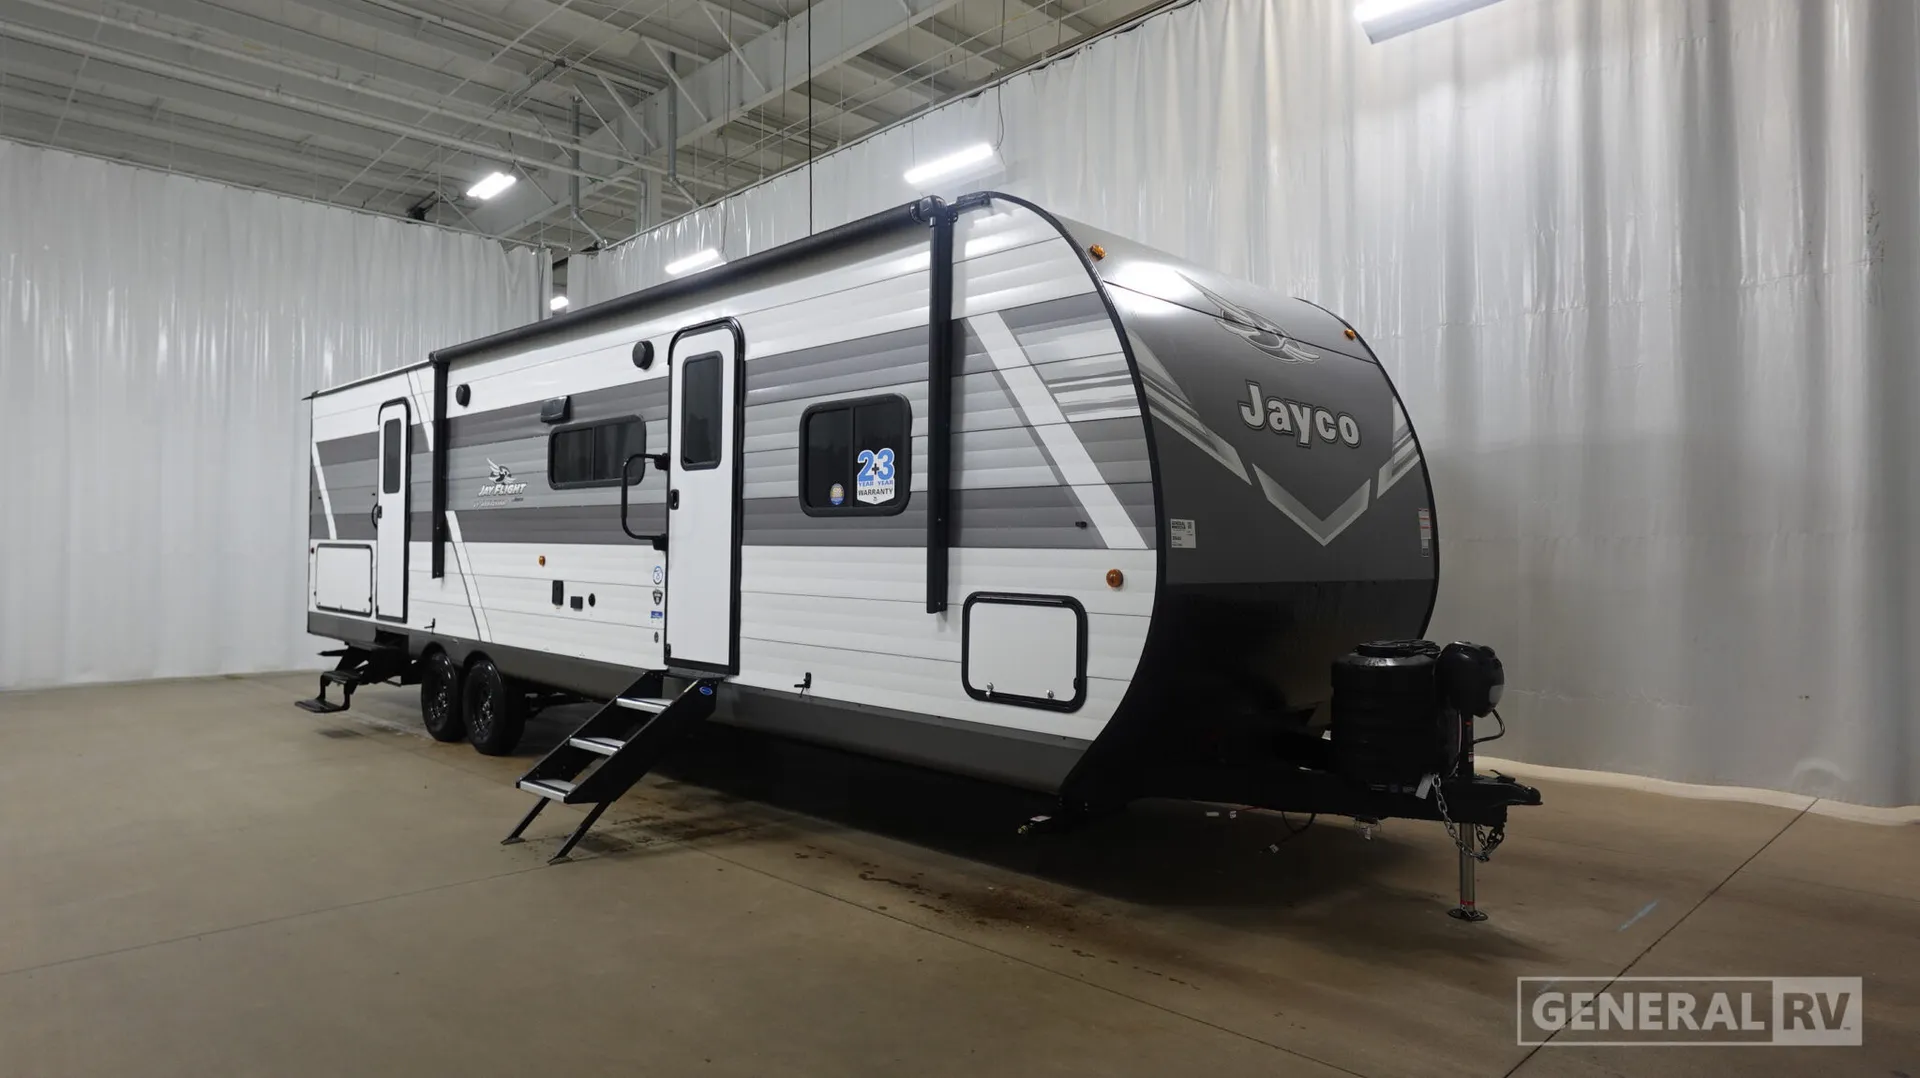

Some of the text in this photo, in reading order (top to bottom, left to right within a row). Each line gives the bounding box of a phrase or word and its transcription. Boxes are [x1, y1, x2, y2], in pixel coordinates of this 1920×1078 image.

[1238, 380, 1361, 449] Jayco
[478, 483, 527, 497] JAY FLIGHT
[858, 488, 893, 496] WARRANTY
